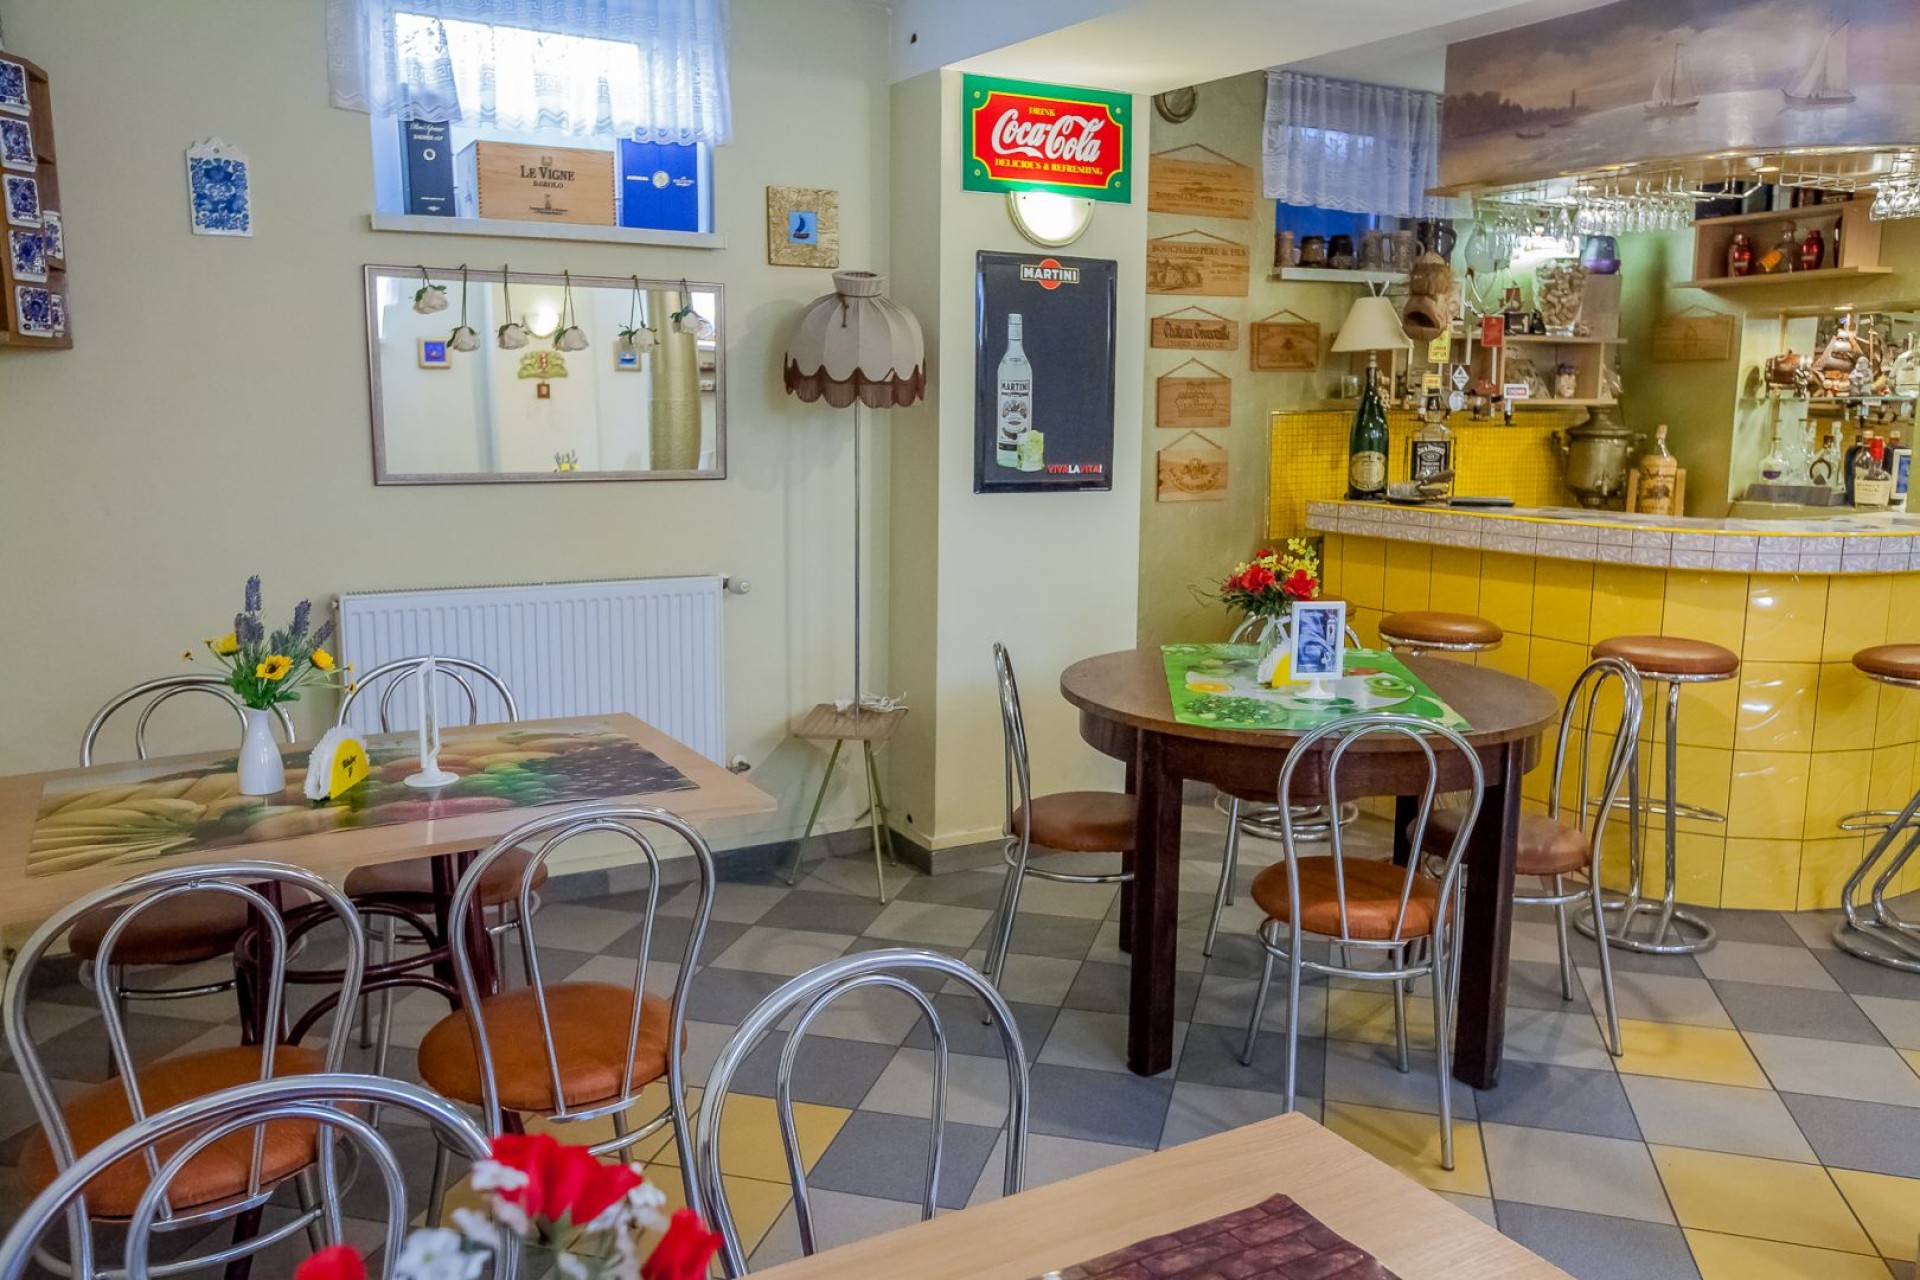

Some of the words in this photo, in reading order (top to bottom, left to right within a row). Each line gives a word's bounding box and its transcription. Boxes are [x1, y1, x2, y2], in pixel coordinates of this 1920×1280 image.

[1028, 106, 1056, 117] DRINK
[991, 108, 1106, 163] Coca-Cola
[995, 157, 1042, 170] DELICIOUS
[1042, 163, 1050, 171] &
[520, 165, 536, 179] LE
[539, 166, 575, 181] VIGNE
[1023, 267, 1077, 281] MARTINI
[1001, 382, 1029, 392] MARTINI
